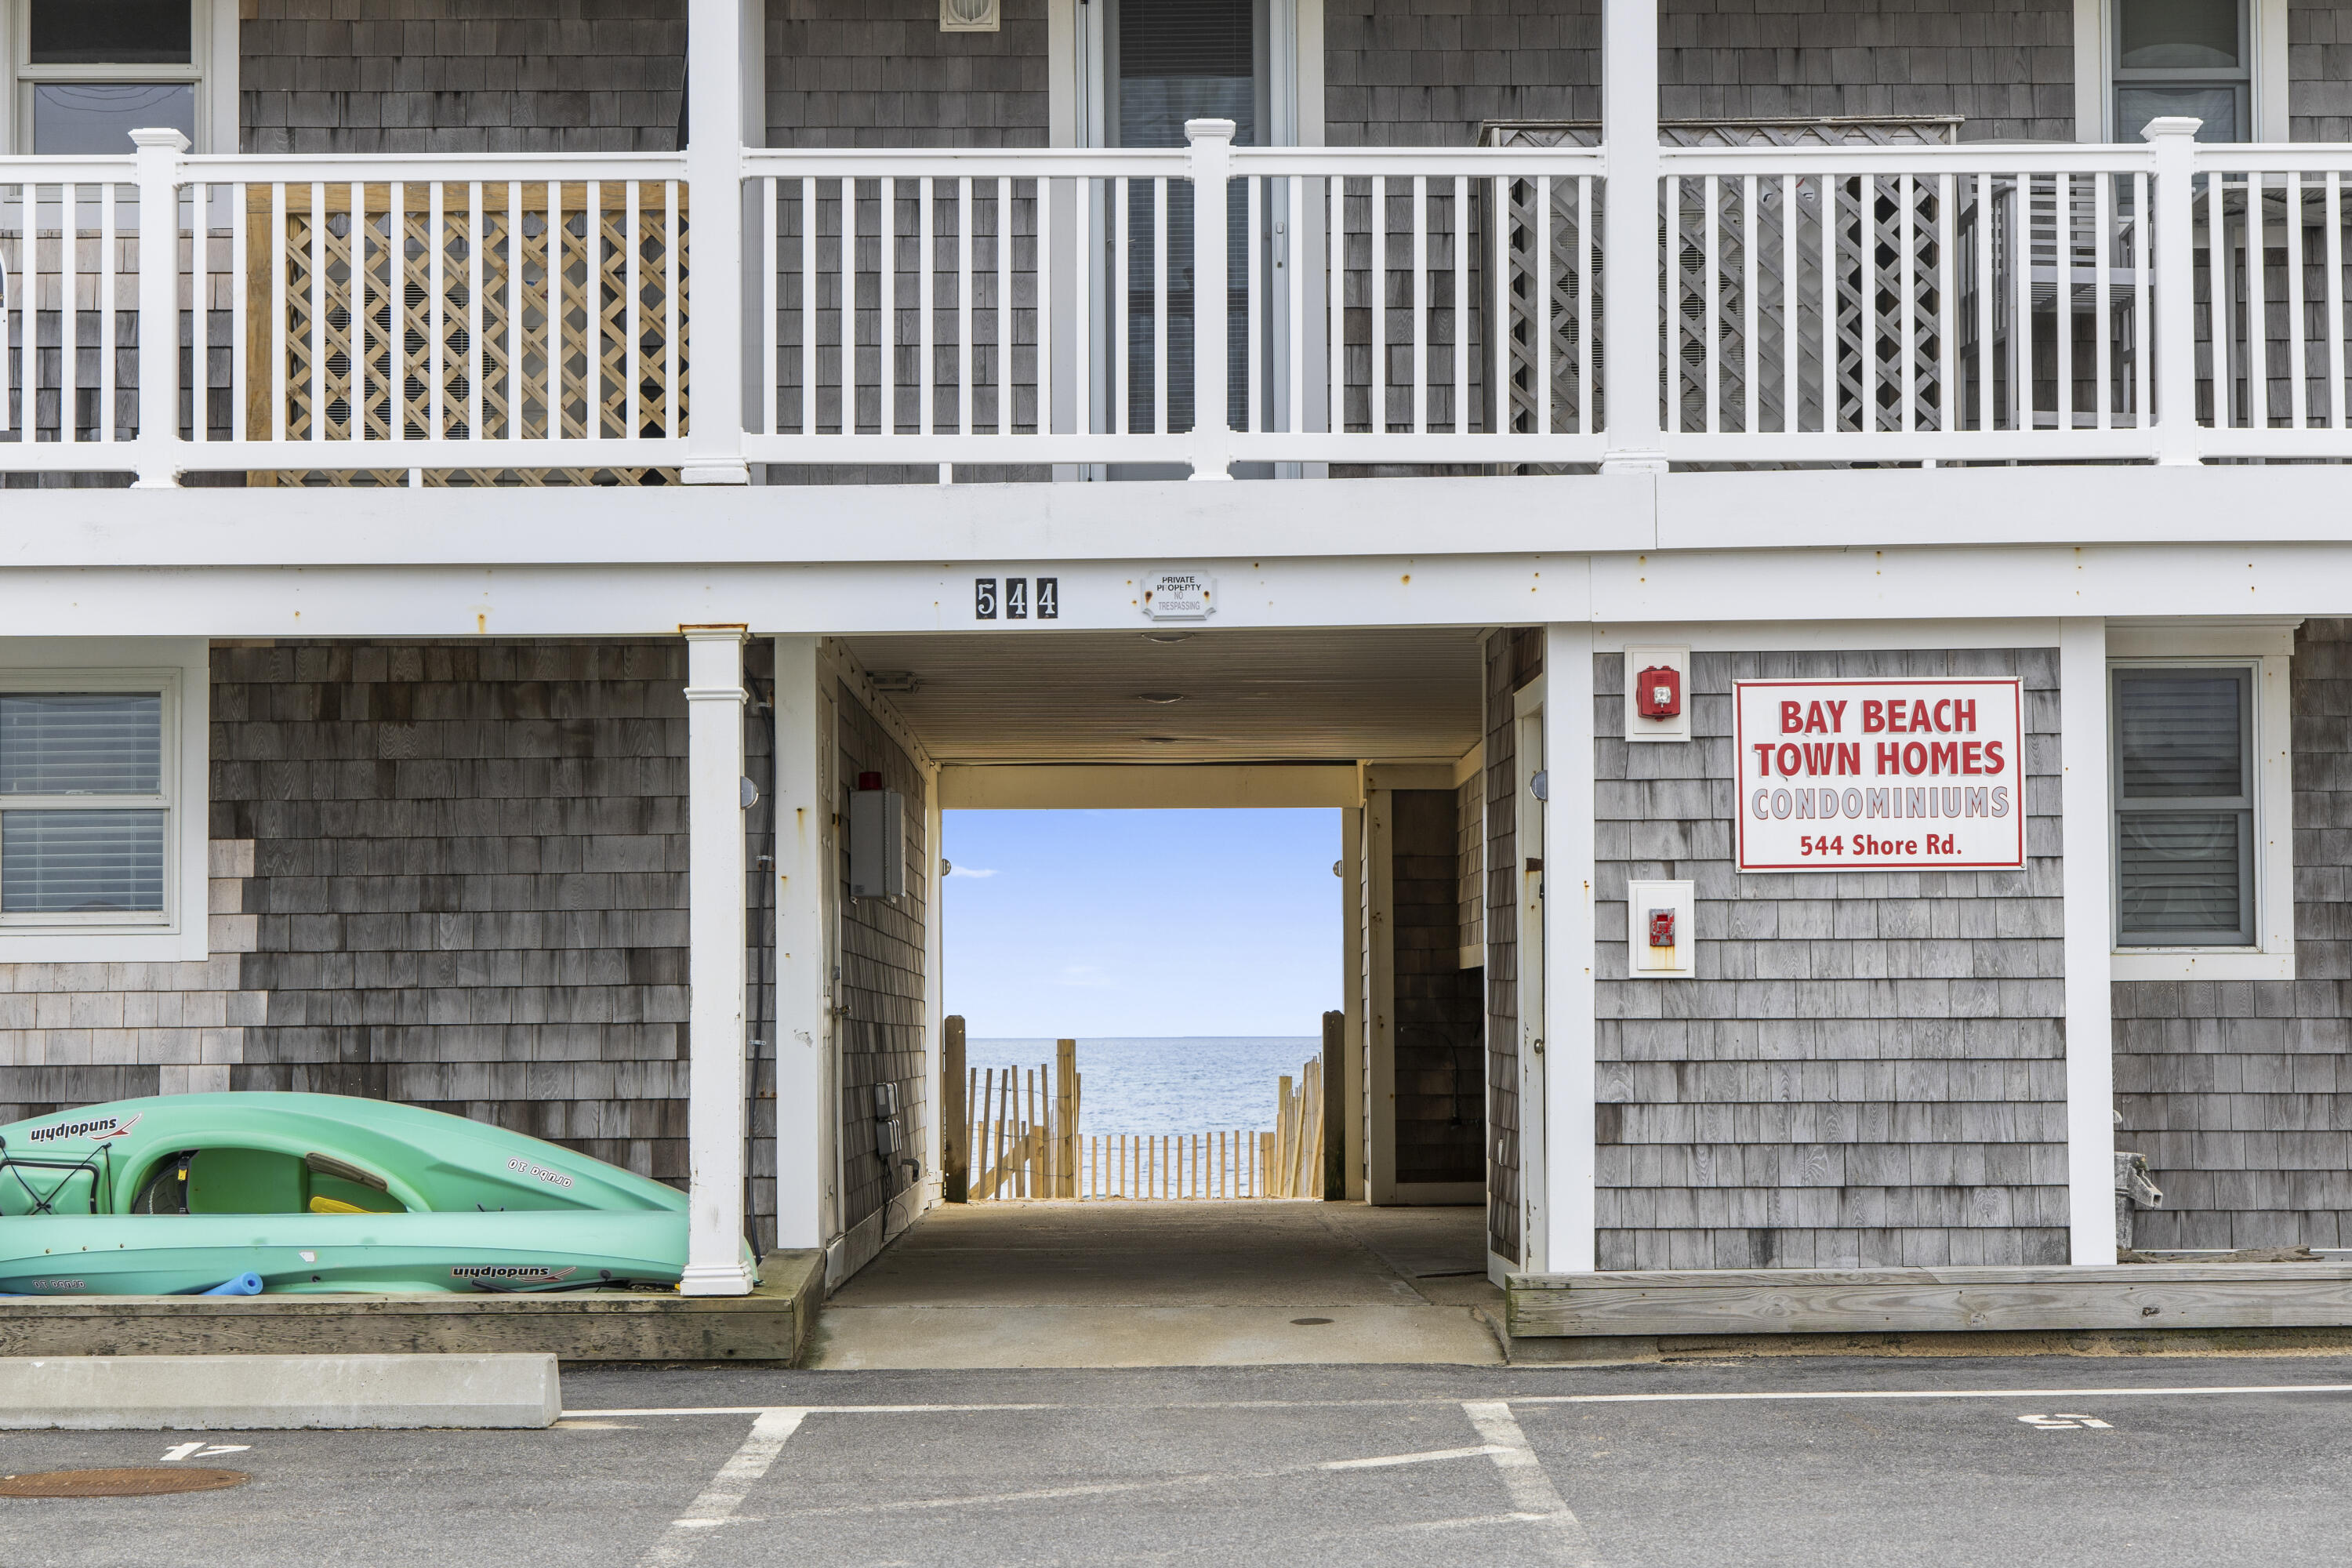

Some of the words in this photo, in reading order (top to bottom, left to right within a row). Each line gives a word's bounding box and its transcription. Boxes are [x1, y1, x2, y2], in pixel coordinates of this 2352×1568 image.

[1162, 575, 1195, 584] PRIVATE
[977, 583, 1056, 615] 544
[1174, 591, 1184, 601] NO
[1158, 601, 1200, 611] TRESPASSING
[1780, 700, 1848, 734] BAY
[1862, 699, 1976, 733] BEACH
[1754, 742, 1860, 776] TOWN
[1876, 740, 2005, 775] HOMES
[1751, 786, 2009, 820] CONDOMINIUMS
[1800, 835, 1844, 856] 544
[1853, 833, 1918, 855] Shore
[1926, 833, 1962, 855] Rd.
[31, 1117, 118, 1142] sundolphin
[507, 1159, 528, 1173] 10
[530, 1166, 572, 1188] aruba
[452, 1266, 550, 1278] sundolphin
[33, 1279, 49, 1290] 10
[50, 1279, 86, 1290] aruba
